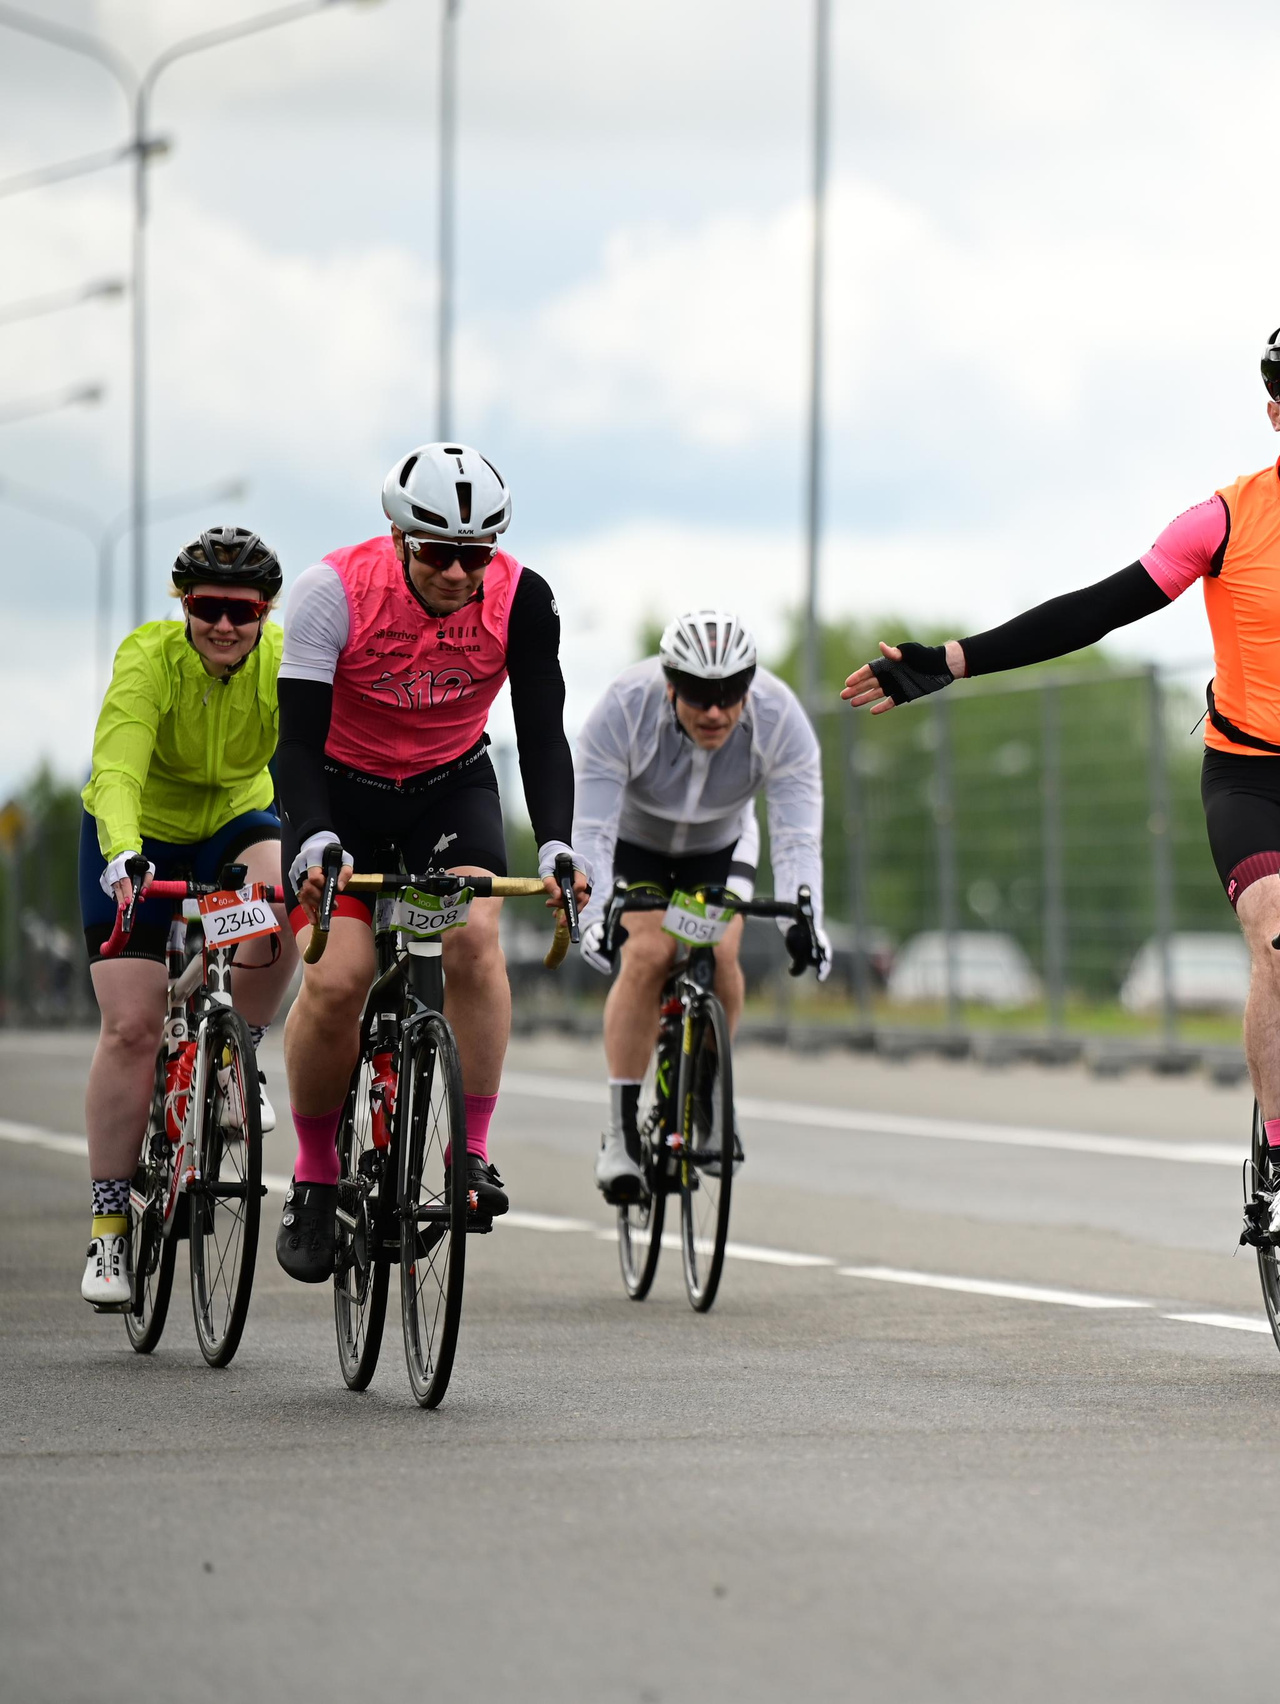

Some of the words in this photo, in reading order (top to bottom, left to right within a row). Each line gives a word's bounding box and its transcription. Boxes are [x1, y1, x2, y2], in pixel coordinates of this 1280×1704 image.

[387, 629, 419, 641] arrivo
[443, 626, 478, 639] OBIK
[218, 898, 228, 906] 60
[565, 888, 576, 927] ULTEGRA
[214, 907, 265, 936] 2340
[407, 910, 458, 930] 1208
